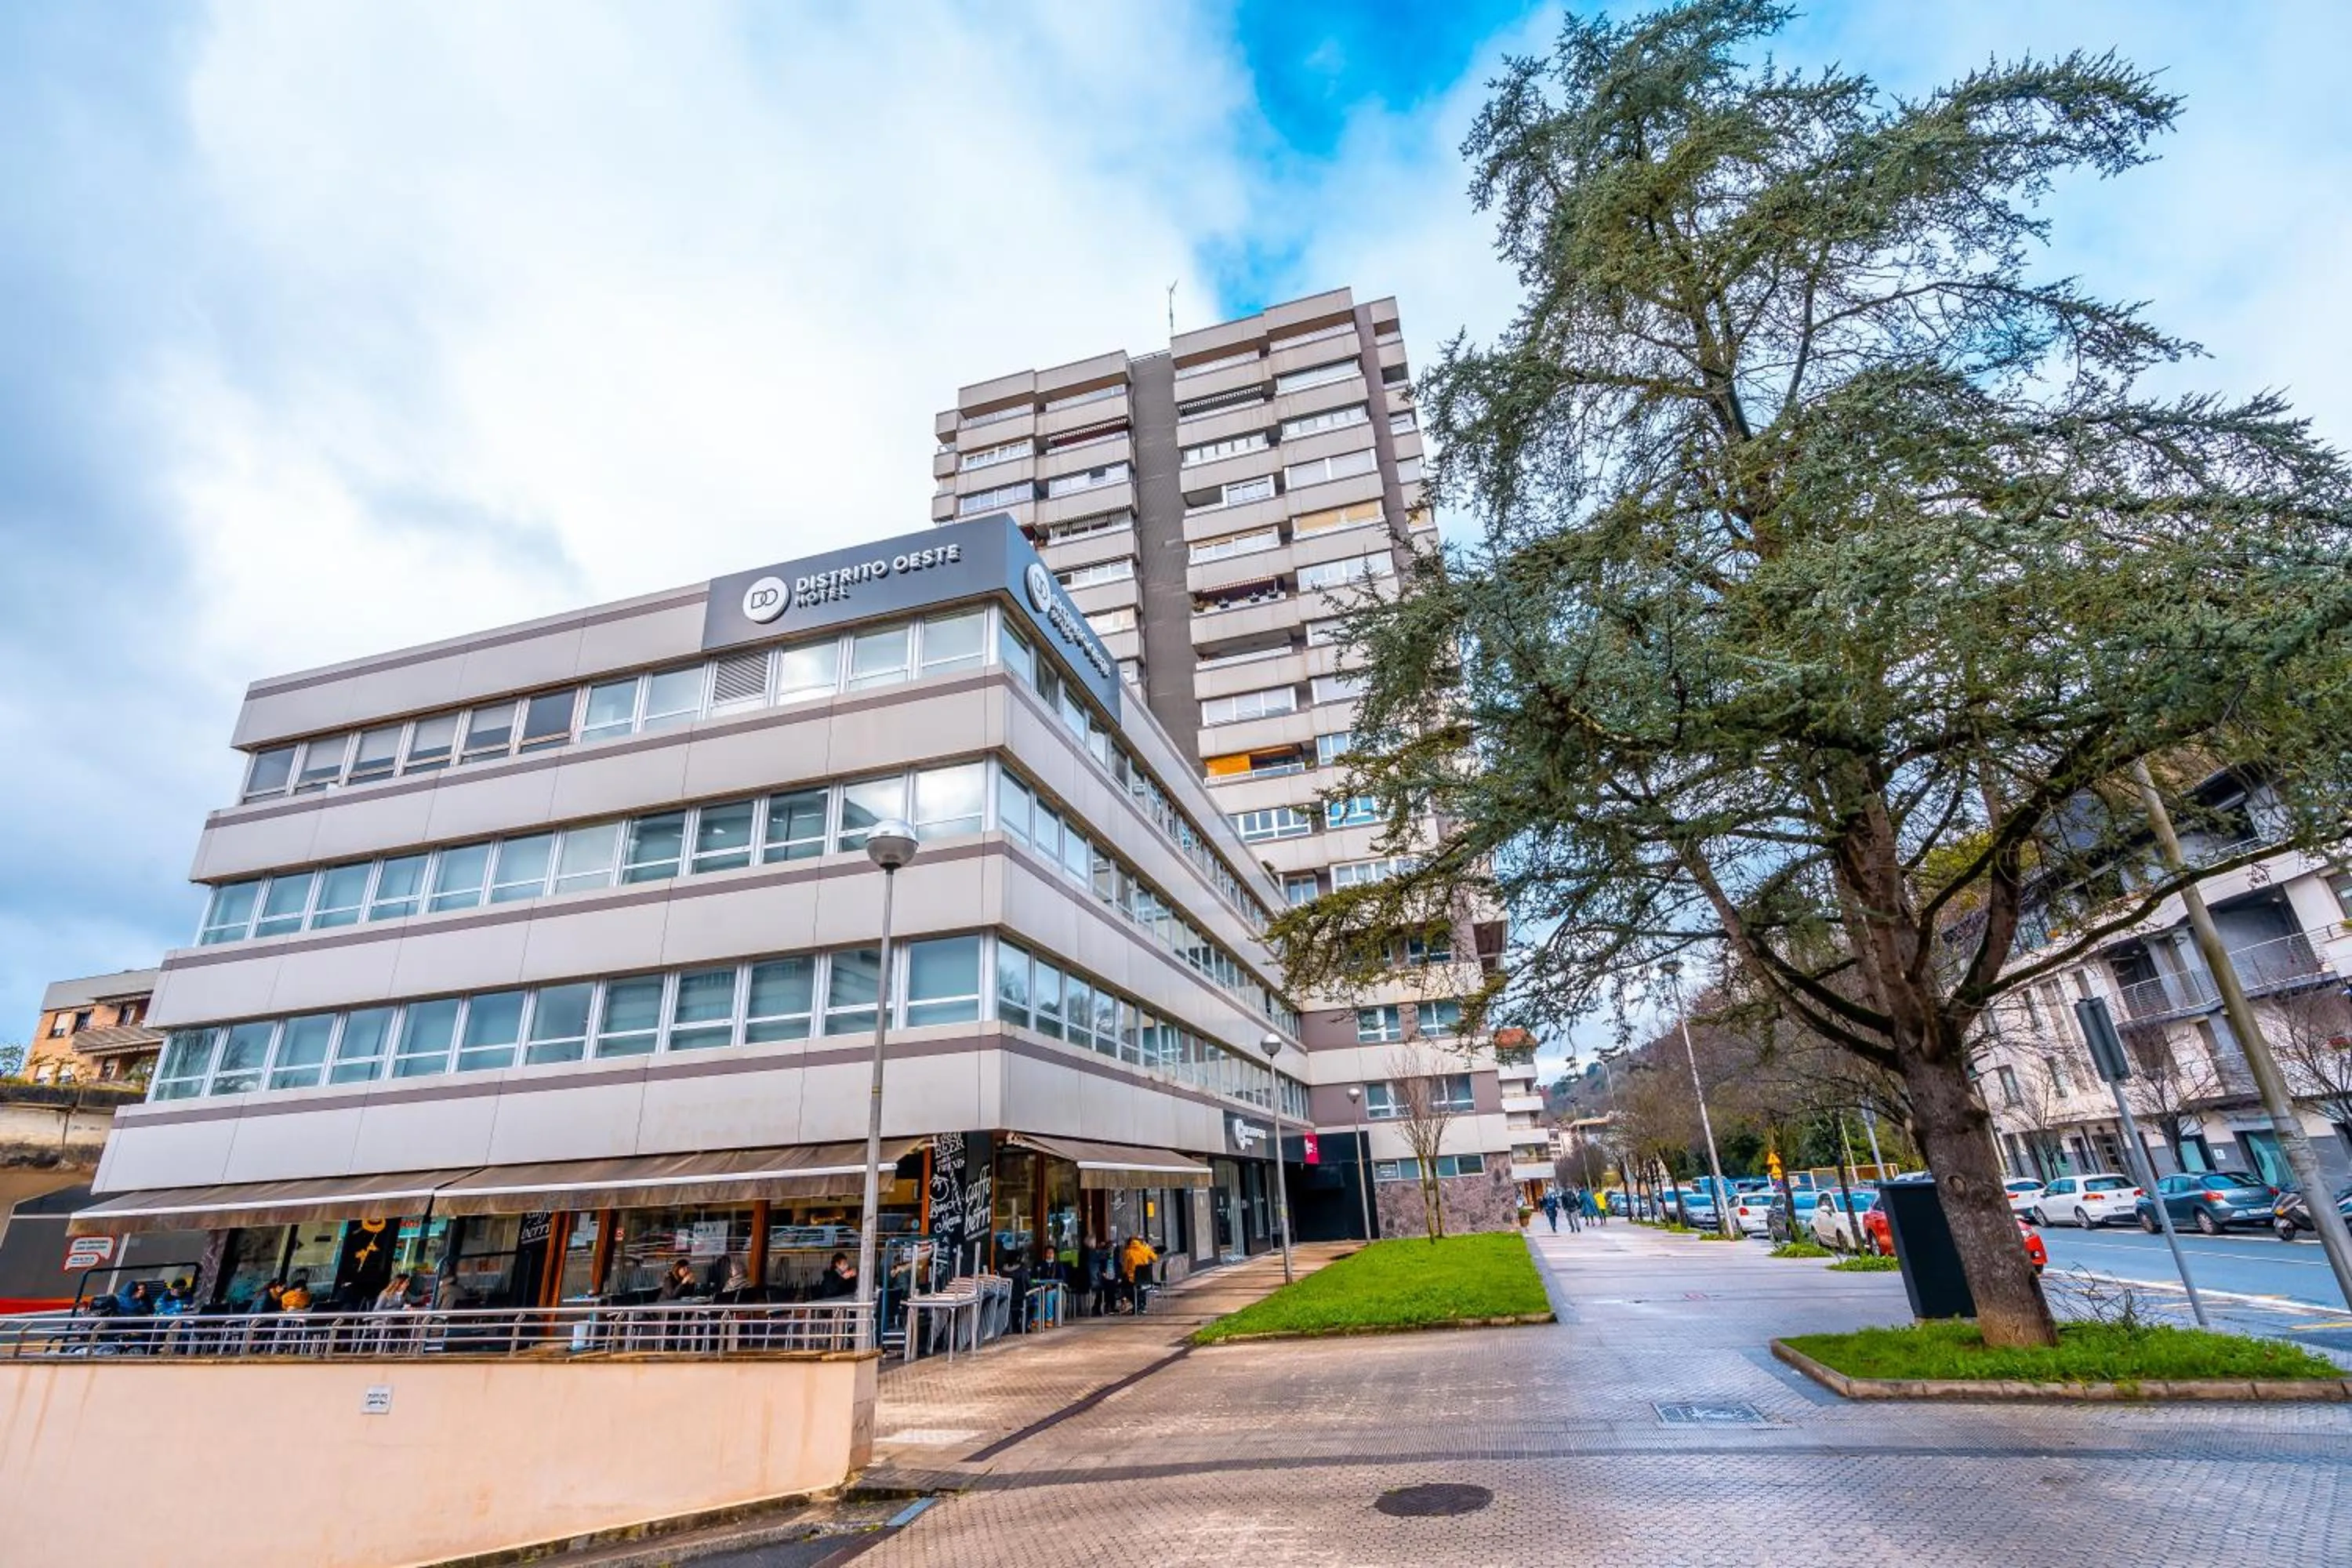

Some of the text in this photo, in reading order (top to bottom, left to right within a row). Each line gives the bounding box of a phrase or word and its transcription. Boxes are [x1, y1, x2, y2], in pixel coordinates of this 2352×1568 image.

[796, 544, 961, 592] DISTRITO OESTE
[794, 585, 850, 608] HOTEL
